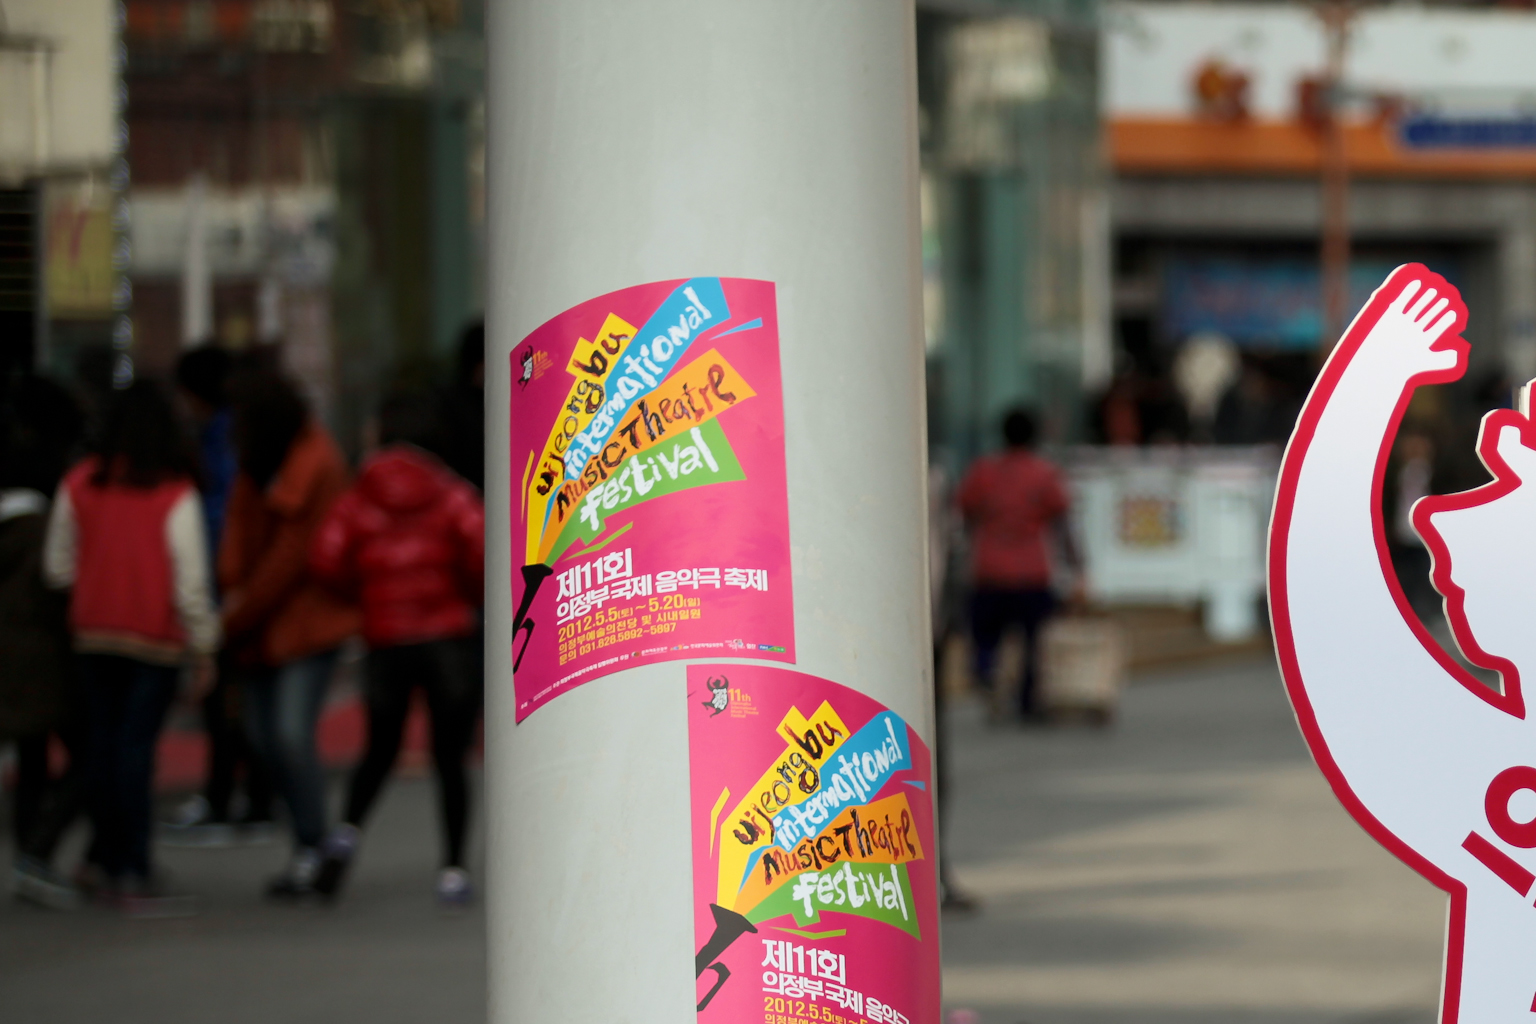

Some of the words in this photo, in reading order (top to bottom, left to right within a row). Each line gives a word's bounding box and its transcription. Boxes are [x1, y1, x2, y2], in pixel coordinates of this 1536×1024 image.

[556, 547, 633, 602] 제11회
[655, 567, 721, 593] 음악극
[724, 567, 768, 591] 축제
[559, 650, 577, 666] 문의
[728, 688, 752, 702] 11th
[761, 939, 846, 986] 제11회
